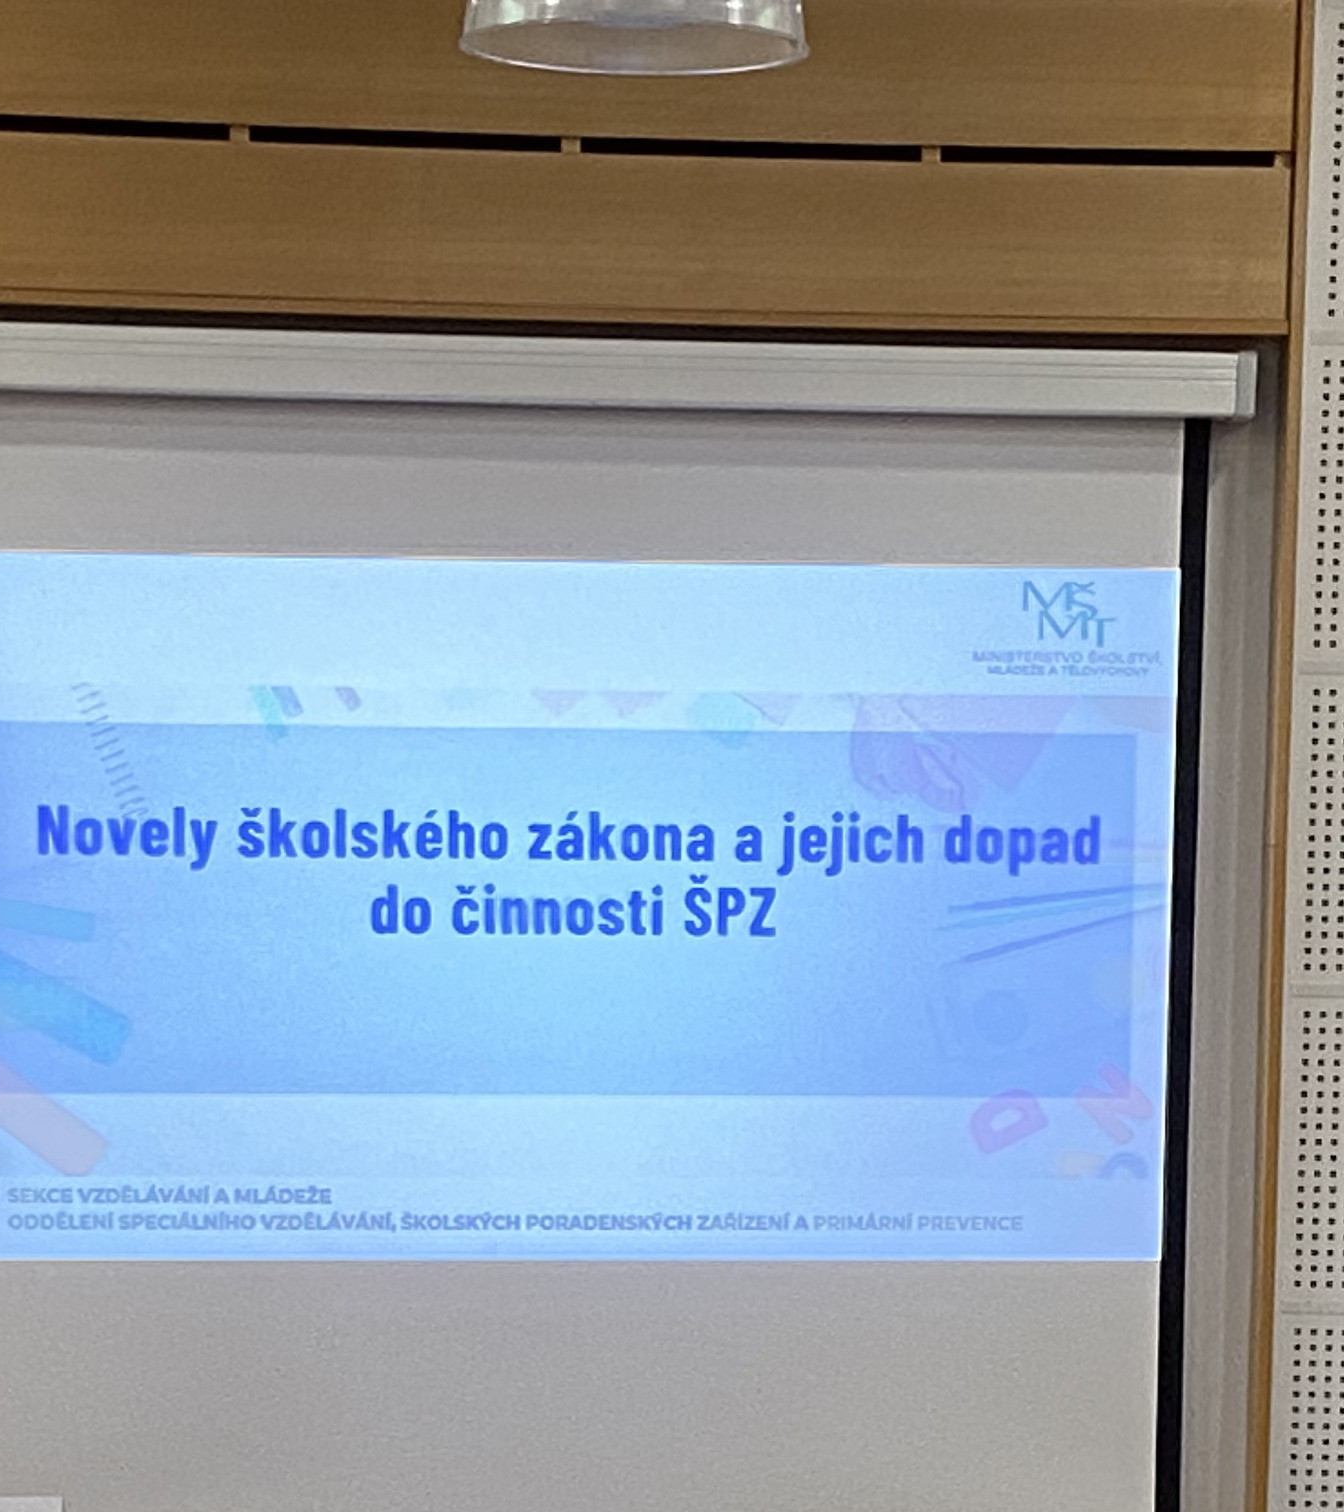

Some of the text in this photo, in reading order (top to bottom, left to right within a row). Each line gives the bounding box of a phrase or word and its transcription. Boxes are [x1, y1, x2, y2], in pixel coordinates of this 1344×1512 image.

[37, 804, 1101, 876] Novely školského zákona a jejich dopad
[371, 874, 777, 937] do činnosti ŠPZ
[7, 1184, 333, 1205] SEKCE VZDĚLÁVÁNÍ A MLÁDEŽE
[7, 1211, 113, 1231] ODDĚLENÍ
[118, 1211, 255, 1231] SPECIÁLNÍHO
[400, 1211, 521, 1231] ŠKOLSKÝCH
[526, 1211, 692, 1231] PORADENSKÝCH
[697, 1211, 789, 1231] ZAŘÍZENÍ
[793, 1214, 809, 1231] A
[813, 1211, 913, 1231] PRIMÁRNÍ
[917, 1214, 1025, 1232] PREVENCE
